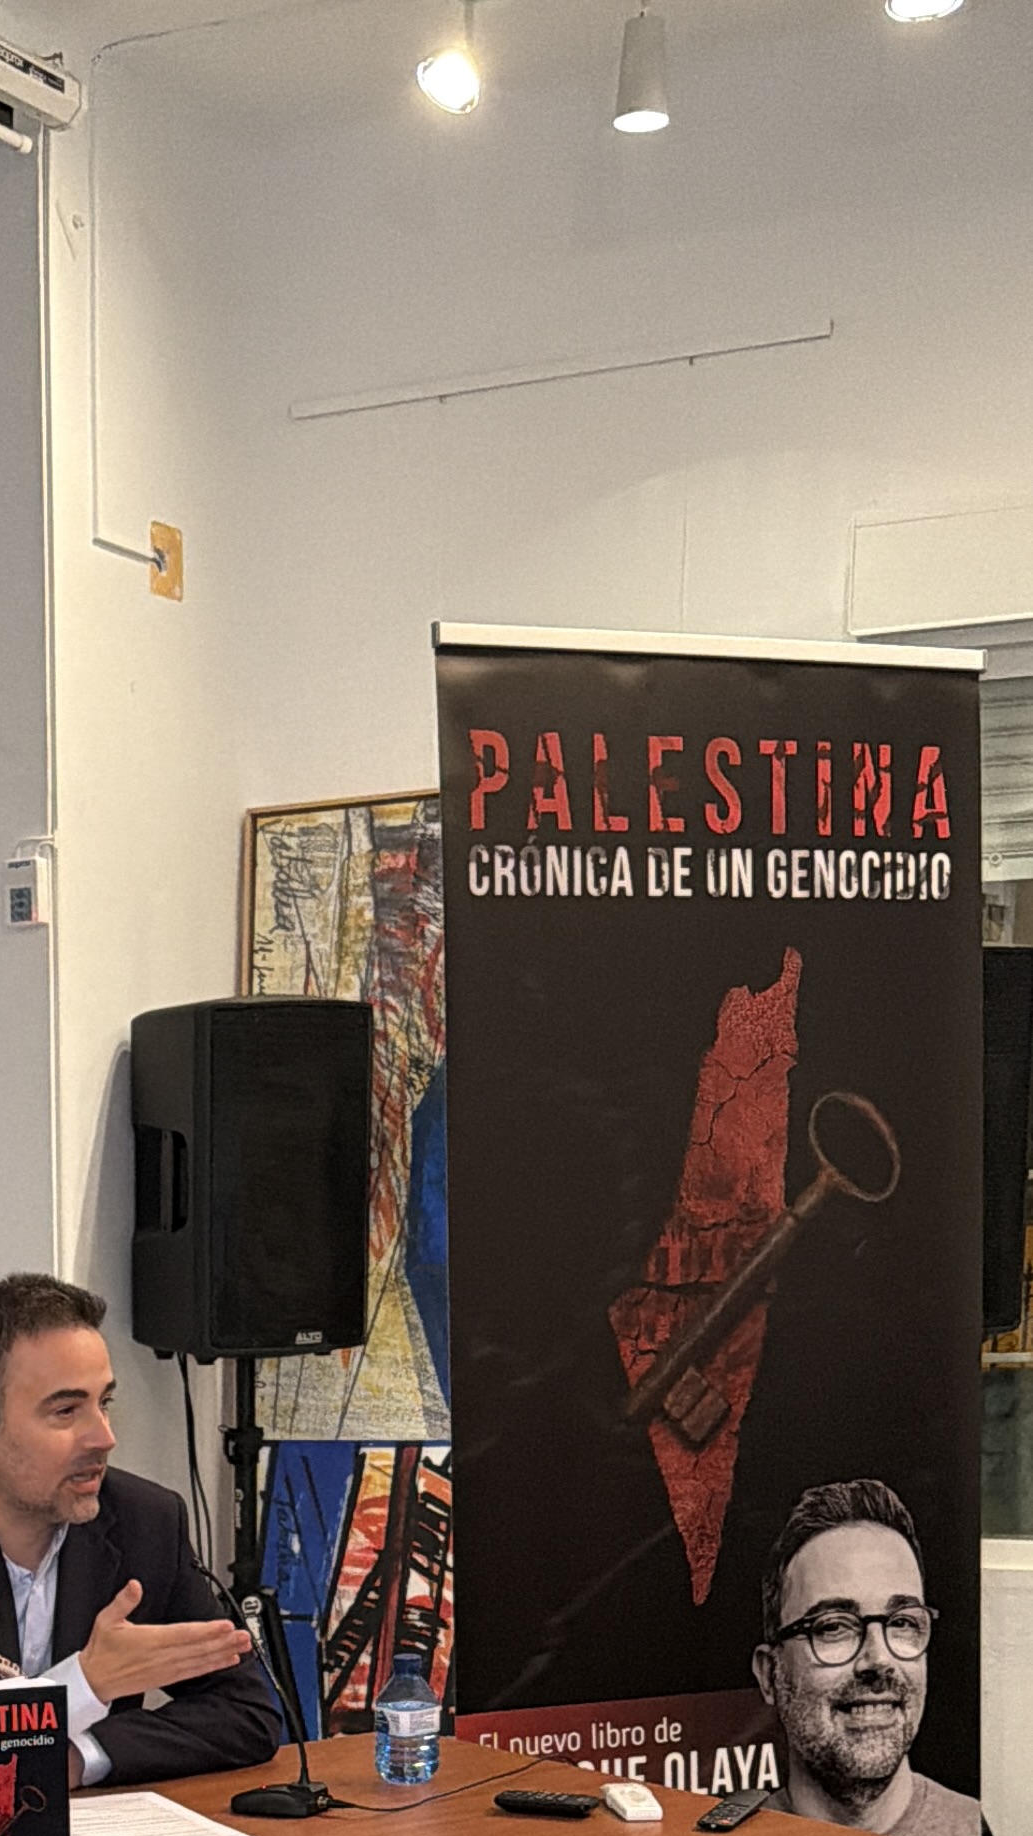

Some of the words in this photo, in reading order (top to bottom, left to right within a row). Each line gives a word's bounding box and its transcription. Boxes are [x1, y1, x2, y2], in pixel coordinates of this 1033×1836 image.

[469, 729, 951, 839] PALESTINA
[469, 836, 634, 898] CRÓNICA
[647, 846, 692, 897] DE
[706, 848, 753, 898] UN
[767, 850, 951, 901] GENOCIDIO
[0, 1734, 55, 1751] genocidio
[509, 1731, 581, 1755] nuevo
[591, 1720, 645, 1750] libro
[654, 1717, 682, 1744] de
[664, 1743, 780, 1795] OLAYA
